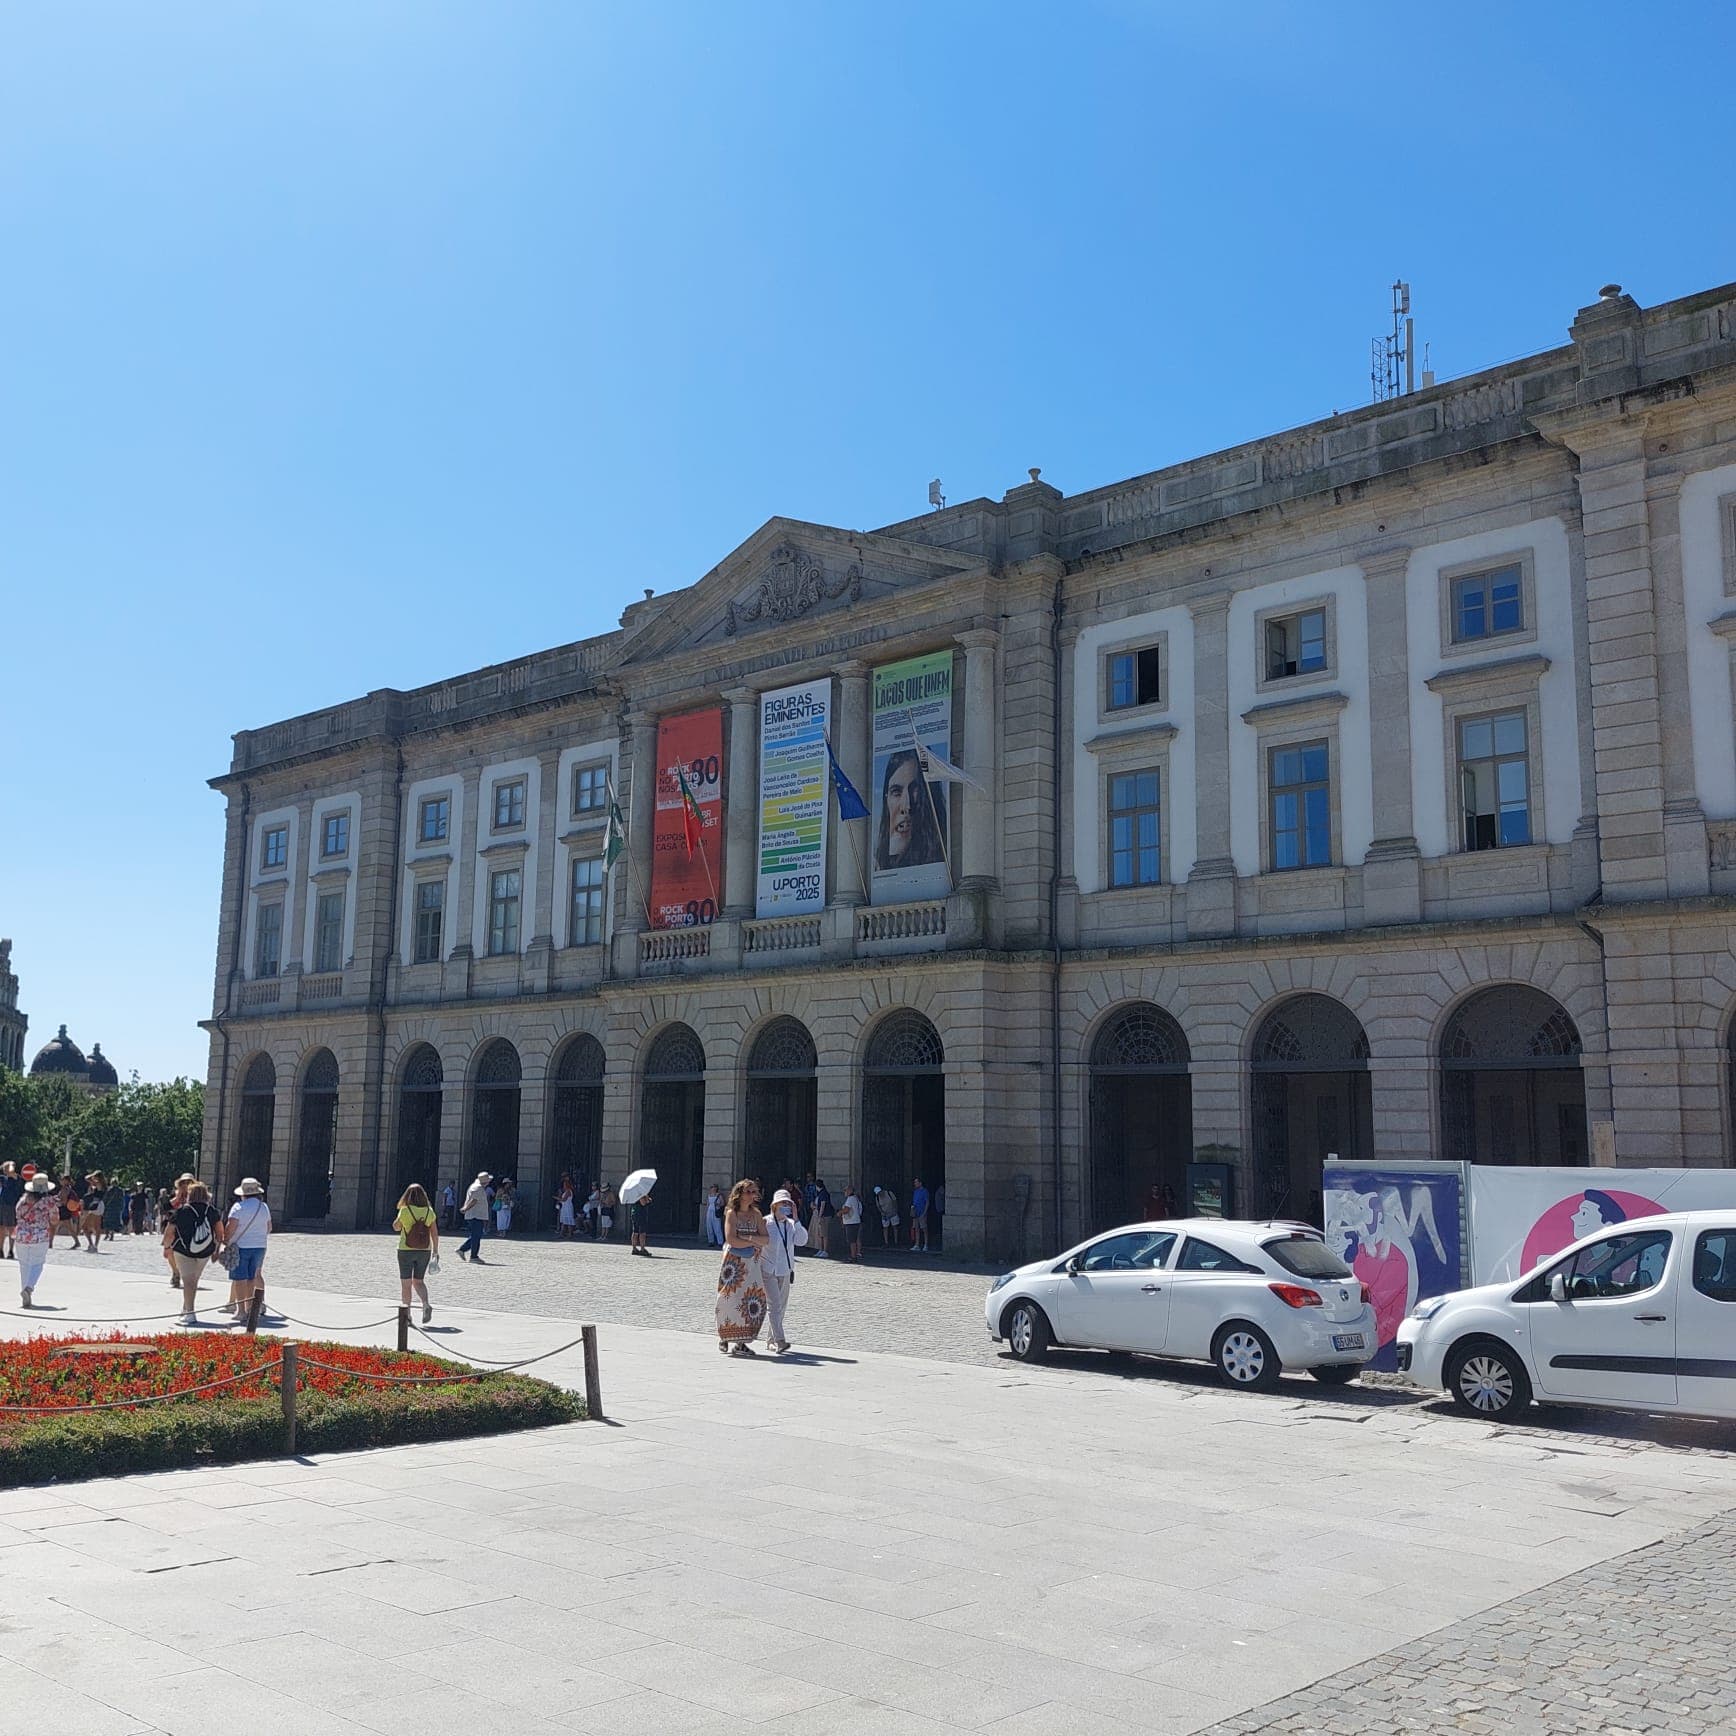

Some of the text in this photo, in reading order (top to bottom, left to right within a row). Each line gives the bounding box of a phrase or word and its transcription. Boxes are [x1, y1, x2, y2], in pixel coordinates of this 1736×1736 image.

[905, 676, 924, 702] QUE
[765, 693, 812, 713] FIGURAS
[765, 702, 825, 725] EMINENTES
[692, 755, 719, 786] 80
[773, 874, 821, 891] U.PORTO
[796, 887, 820, 901] 2025
[660, 904, 684, 914] ROCK
[665, 912, 693, 923] PORTO
[687, 898, 714, 925] 80
